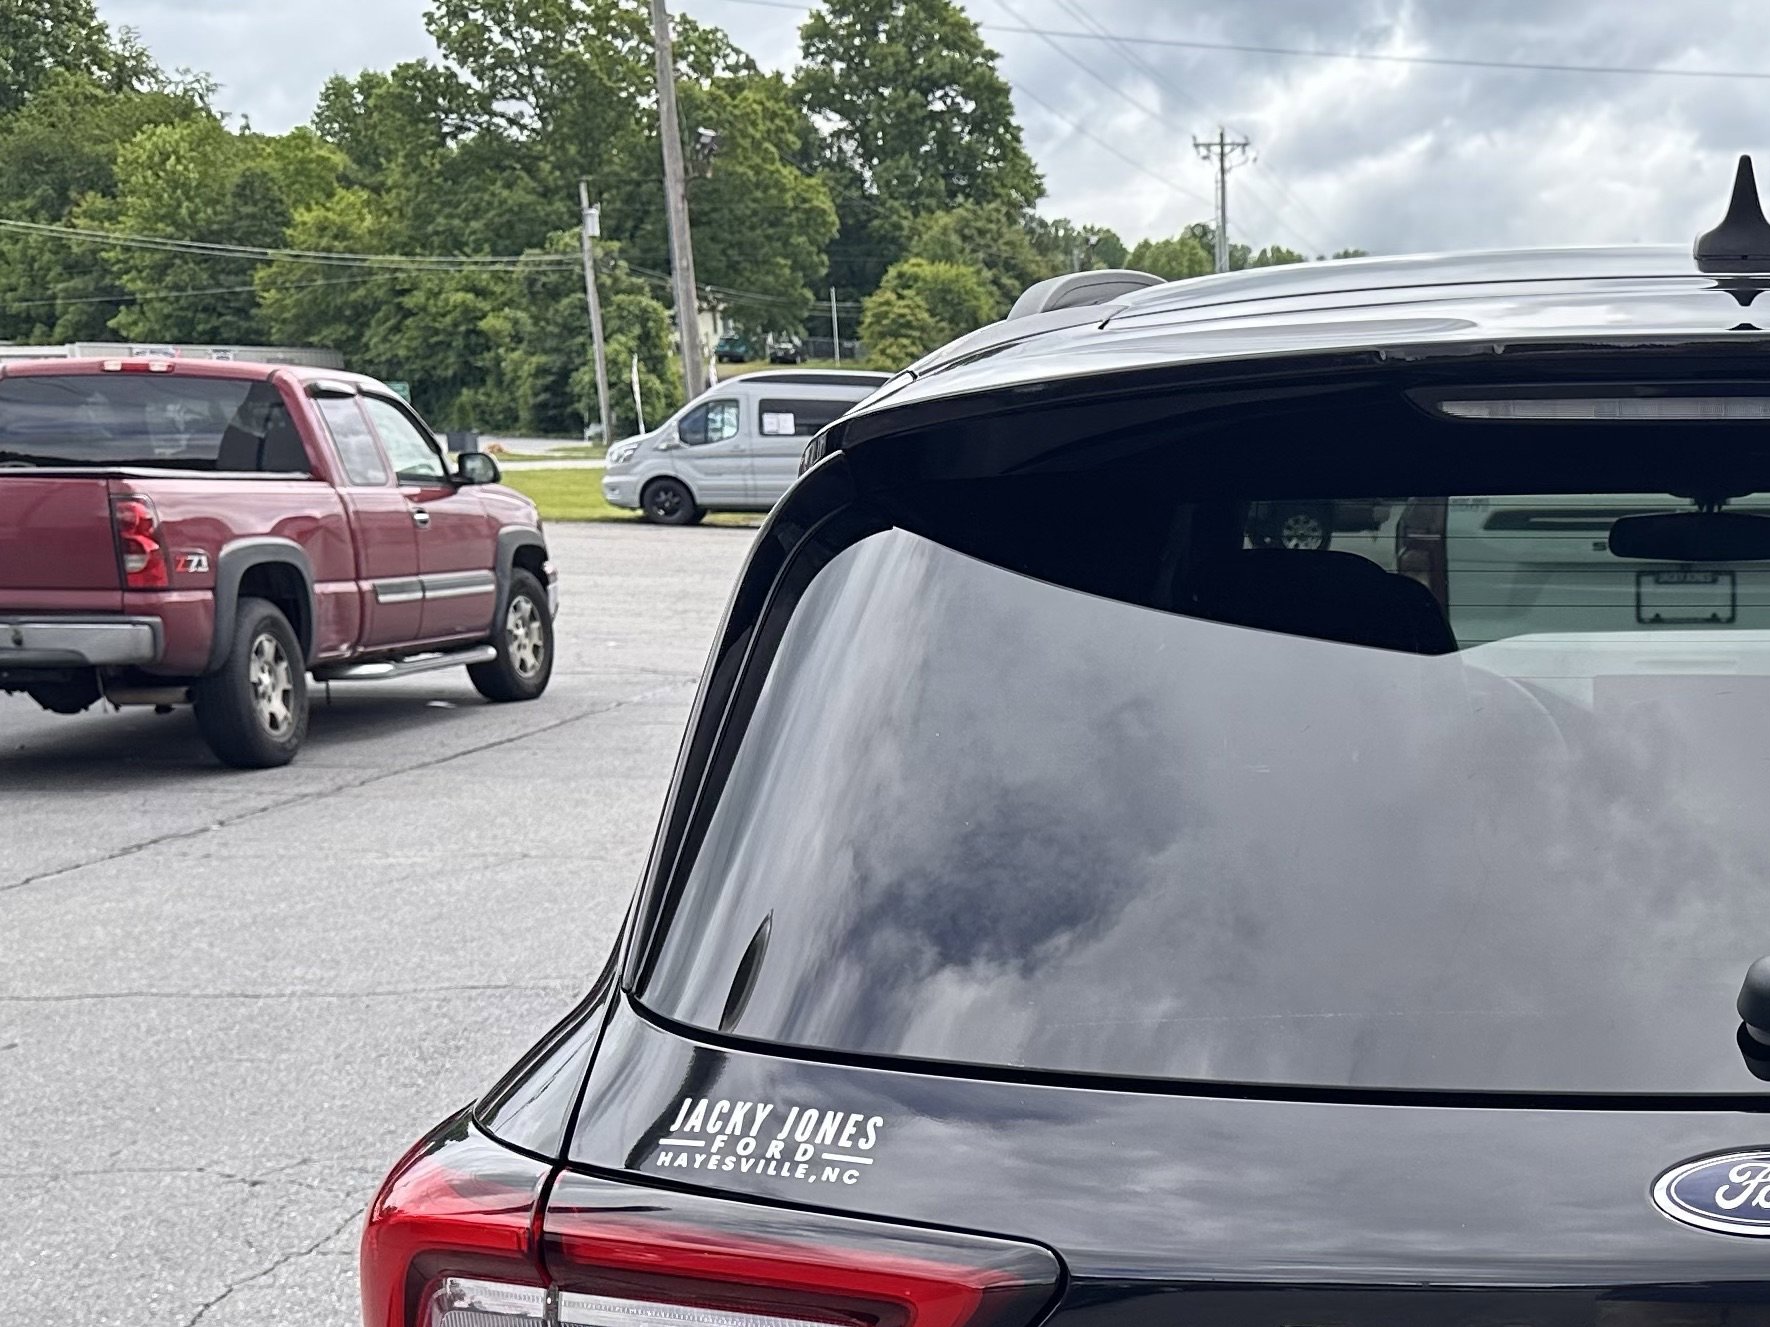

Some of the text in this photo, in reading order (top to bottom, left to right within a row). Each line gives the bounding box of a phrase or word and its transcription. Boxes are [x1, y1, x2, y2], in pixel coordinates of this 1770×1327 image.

[175, 554, 209, 573] Z71
[669, 1097, 884, 1150] JACKY JONES
[710, 1134, 815, 1162] FORD
